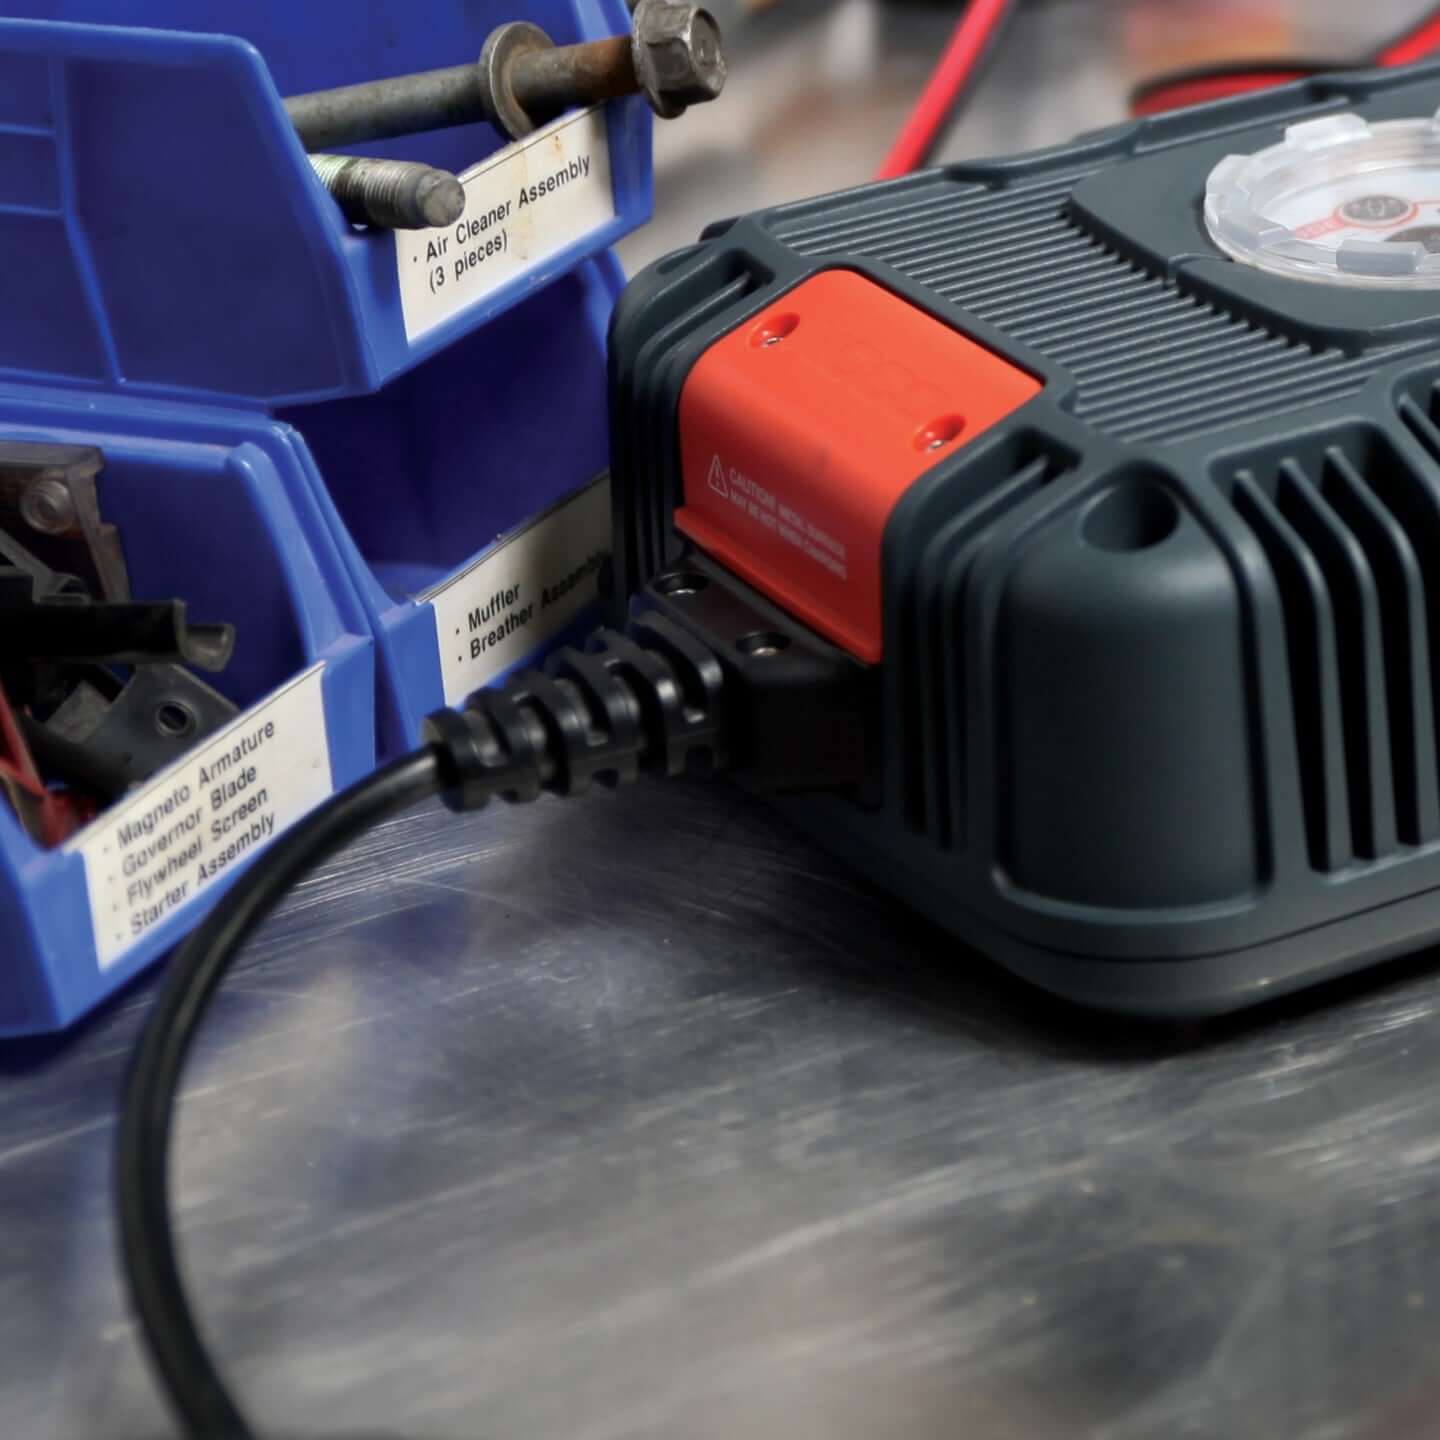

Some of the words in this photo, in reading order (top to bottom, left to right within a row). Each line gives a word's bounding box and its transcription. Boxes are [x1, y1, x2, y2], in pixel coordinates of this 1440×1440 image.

[426, 236, 448, 263] Air
[456, 200, 511, 245] Cleaner
[519, 156, 590, 208] Assembly
[430, 267, 445, 294] (3
[455, 229, 507, 280] pieces)
[468, 583, 520, 633] Muffler
[470, 602, 534, 660] Breather
[117, 784, 191, 849] Magneto
[198, 721, 275, 789] Armature
[122, 807, 203, 878] Governor
[210, 765, 257, 811] Blade
[126, 836, 203, 907] Flywheel
[210, 788, 268, 842] Screen
[131, 880, 189, 936] Starter
[197, 812, 275, 887] Assembly
